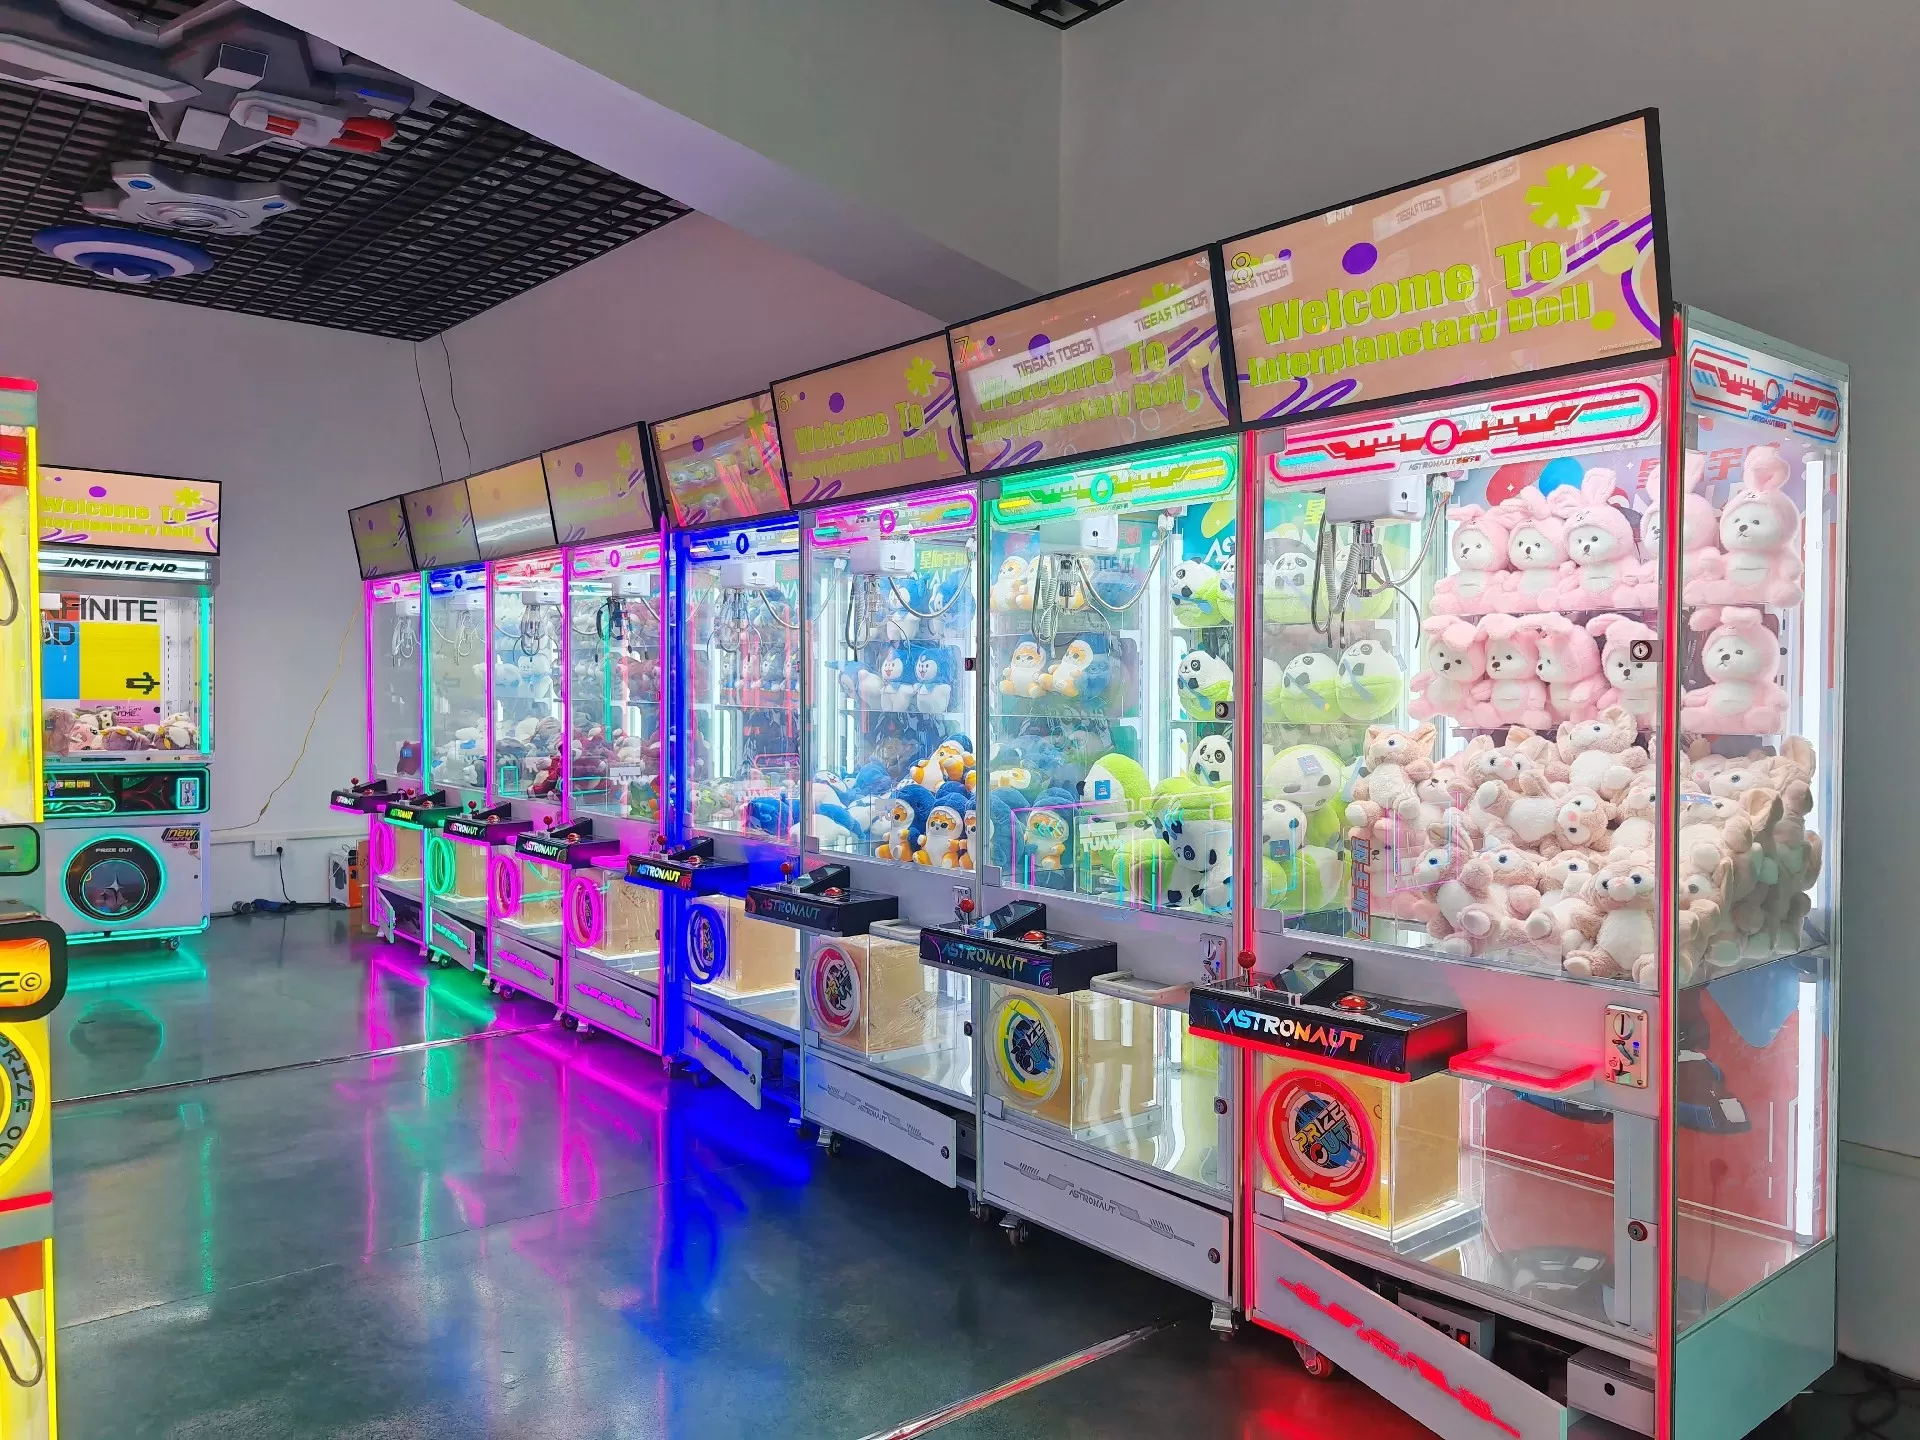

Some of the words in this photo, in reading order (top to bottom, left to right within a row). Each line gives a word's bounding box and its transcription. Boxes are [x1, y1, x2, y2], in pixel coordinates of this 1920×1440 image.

[1258, 263, 1476, 345] Welcome
[1495, 239, 1563, 291] To
[1248, 306, 1500, 387] Interplanetary
[1506, 281, 1593, 333] Doll
[1125, 340, 1167, 375] To
[1132, 373, 1185, 410] Doll
[794, 412, 889, 454] Welcome
[894, 401, 924, 431] To
[44, 497, 150, 520] Welcome
[159, 505, 187, 523] To
[523, 841, 559, 857] ASTRONAUT
[636, 863, 681, 883] ASTRONAUT
[760, 898, 821, 921] ASTRONAUT
[941, 940, 1029, 972] ASTRONAUT
[1223, 1007, 1364, 1052] ASTRONAUT
[1292, 1100, 1347, 1153] PRIZE
[1310, 1121, 1353, 1166] OUT
[1068, 1189, 1117, 1215] ASTRONAUT
